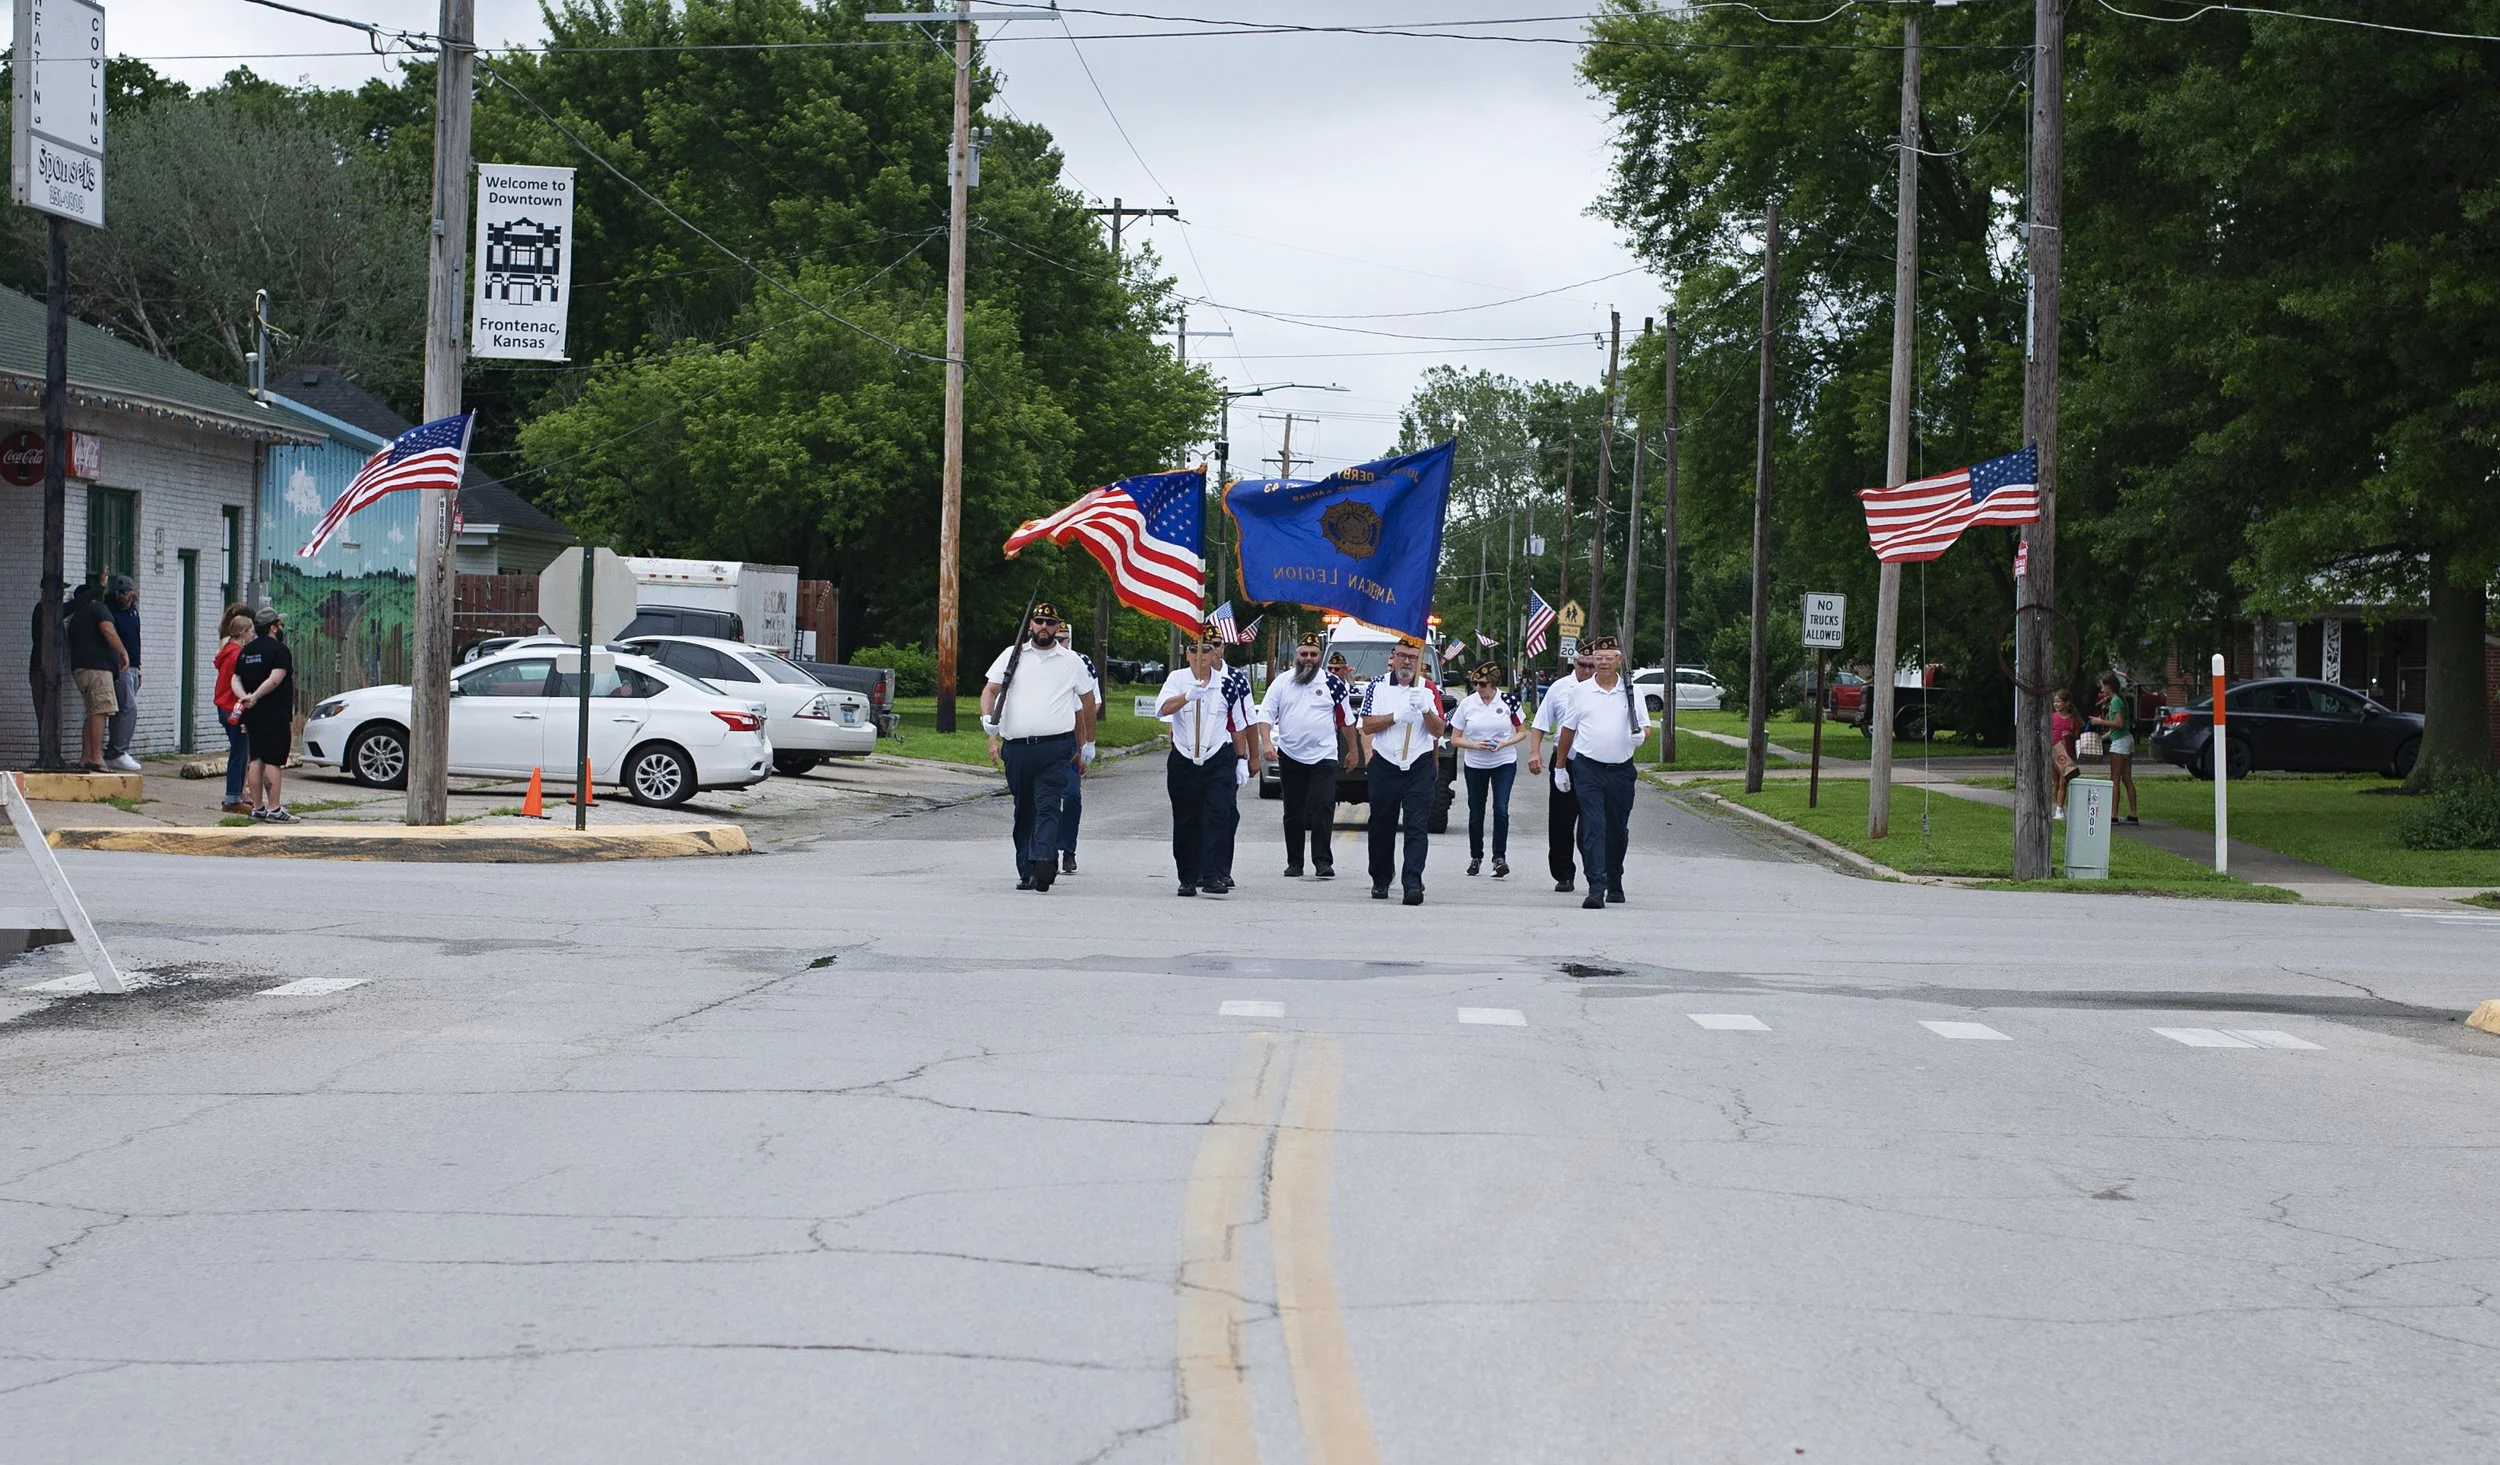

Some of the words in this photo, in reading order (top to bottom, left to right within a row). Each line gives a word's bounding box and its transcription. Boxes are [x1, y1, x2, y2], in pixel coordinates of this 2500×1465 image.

[485, 176, 548, 191] Welcome
[552, 180, 566, 191] to
[489, 192, 563, 207] Downtown
[480, 317, 560, 336] Frontenac,
[493, 334, 546, 349] Kansas
[1817, 599, 1833, 611] NO
[1810, 614, 1839, 626] TRUCKS
[1805, 628, 1841, 641] ALLOWED
[1561, 647, 1575, 656] 20
